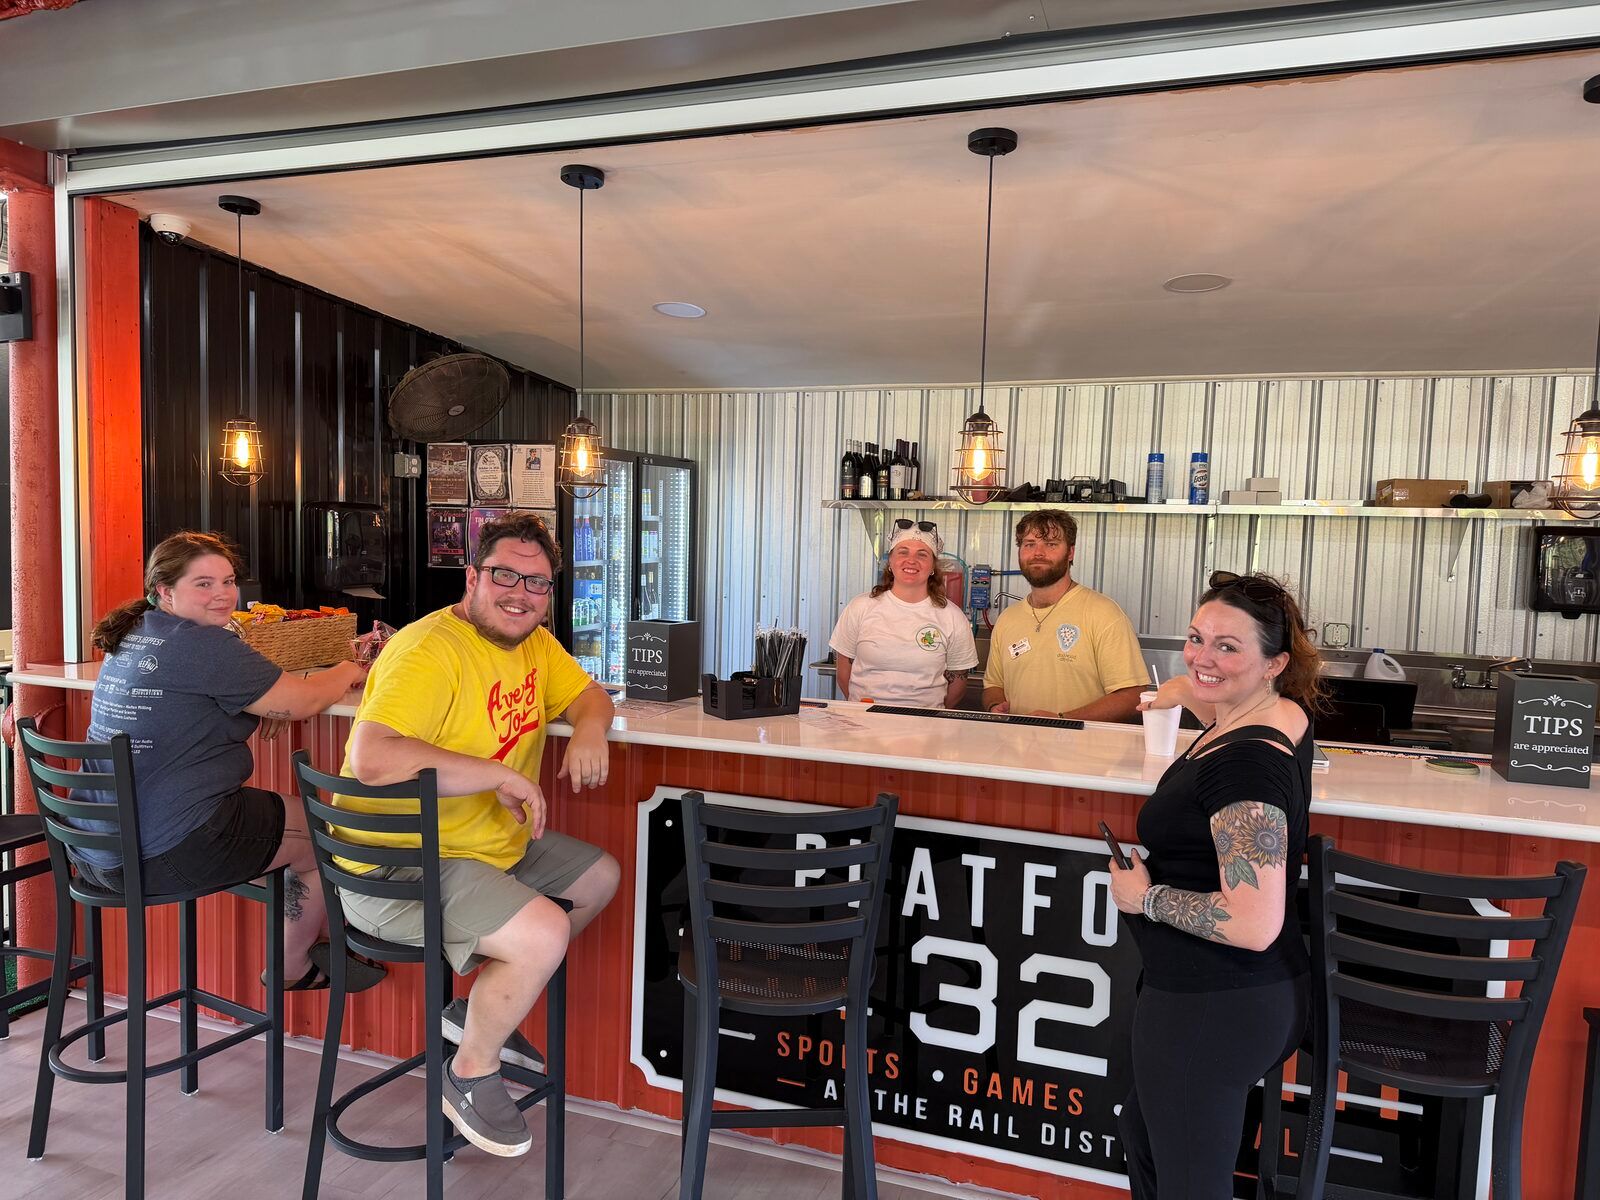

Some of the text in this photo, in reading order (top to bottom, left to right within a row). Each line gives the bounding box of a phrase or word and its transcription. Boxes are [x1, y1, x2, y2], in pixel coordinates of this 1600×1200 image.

[632, 648, 663, 664] TIPS
[637, 669, 667, 677] appreciated
[1523, 714, 1583, 737] TIPS
[1513, 742, 1589, 755] are appreciated
[909, 935, 1112, 1078] 32
[963, 1067, 1084, 1116] GAMES
[874, 1088, 928, 1120] THE
[948, 1103, 1020, 1139] RAIL
[1041, 1122, 1127, 1162] DIST
